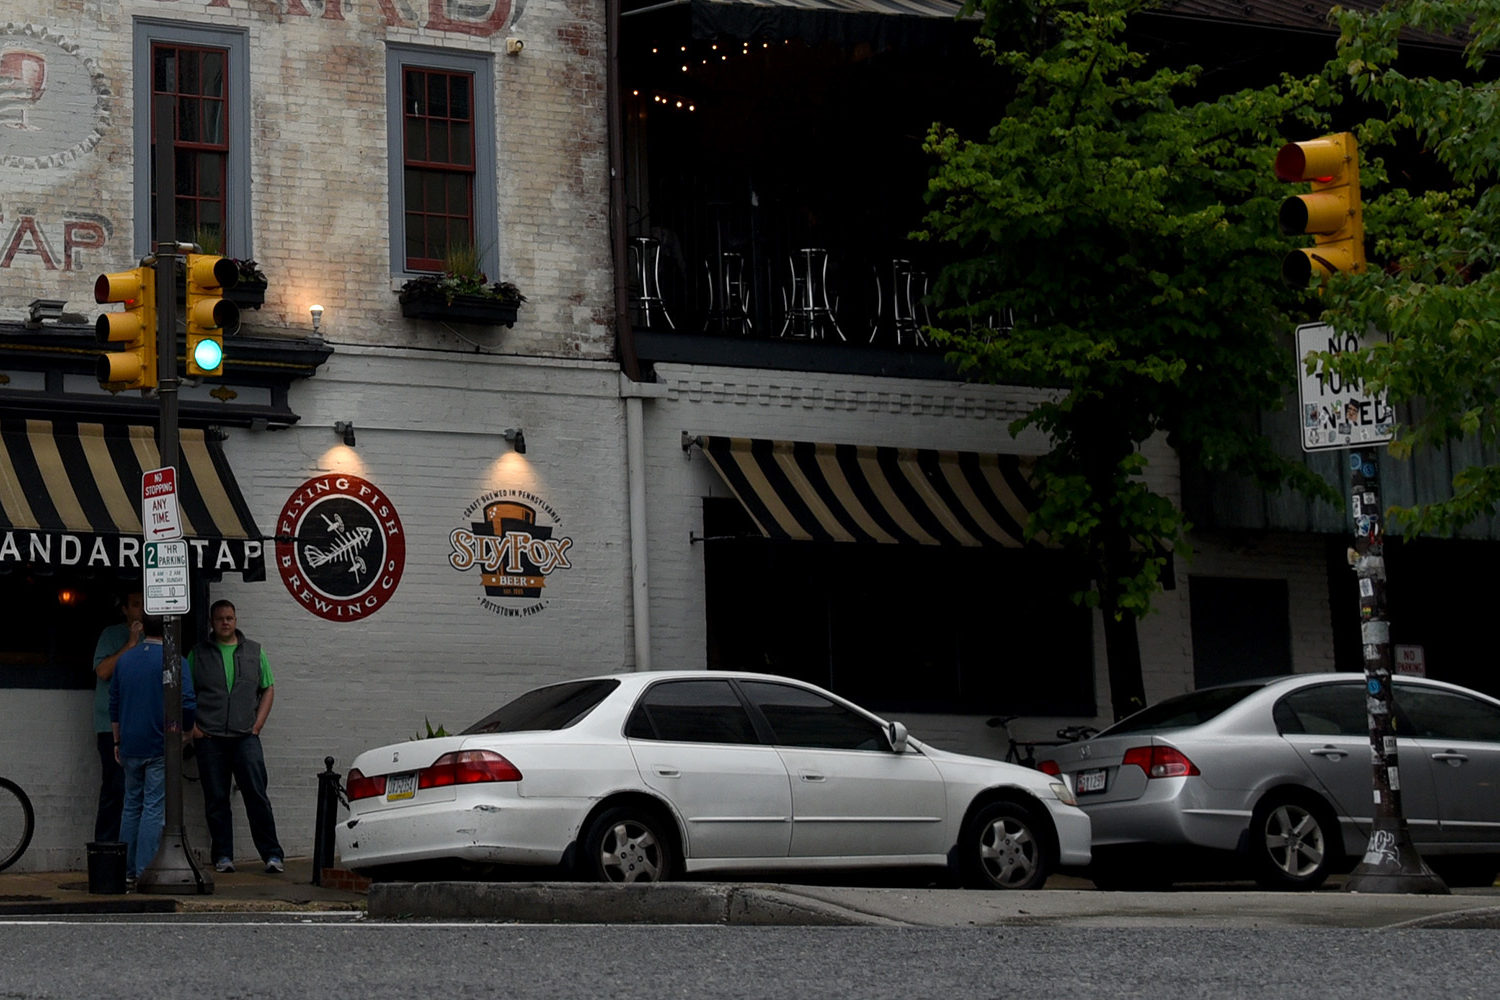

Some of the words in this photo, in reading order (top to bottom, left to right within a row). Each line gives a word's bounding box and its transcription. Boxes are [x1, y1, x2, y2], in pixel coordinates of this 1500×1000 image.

[1328, 335, 1358, 354] NO
[153, 472, 163, 483] NO
[145, 481, 173, 497] STOPPING
[152, 498, 167, 511] ANY
[282, 478, 350, 534] FLYING
[358, 484, 400, 537] FISH
[463, 499, 482, 518] CRAFT
[481, 489, 508, 504] BREWED
[509, 489, 517, 497] IN
[518, 490, 562, 524] PENNSYLVANIA
[152, 511, 170, 525] TIME
[147, 546, 156, 566] 2
[166, 544, 178, 554] HR
[158, 555, 186, 566] PARKING
[187, 539, 263, 570] TAP
[281, 554, 378, 616] BREWING
[499, 576, 528, 586] BEER
[480, 598, 522, 618] POTTSTOWN,
[1403, 650, 1415, 661] NO
